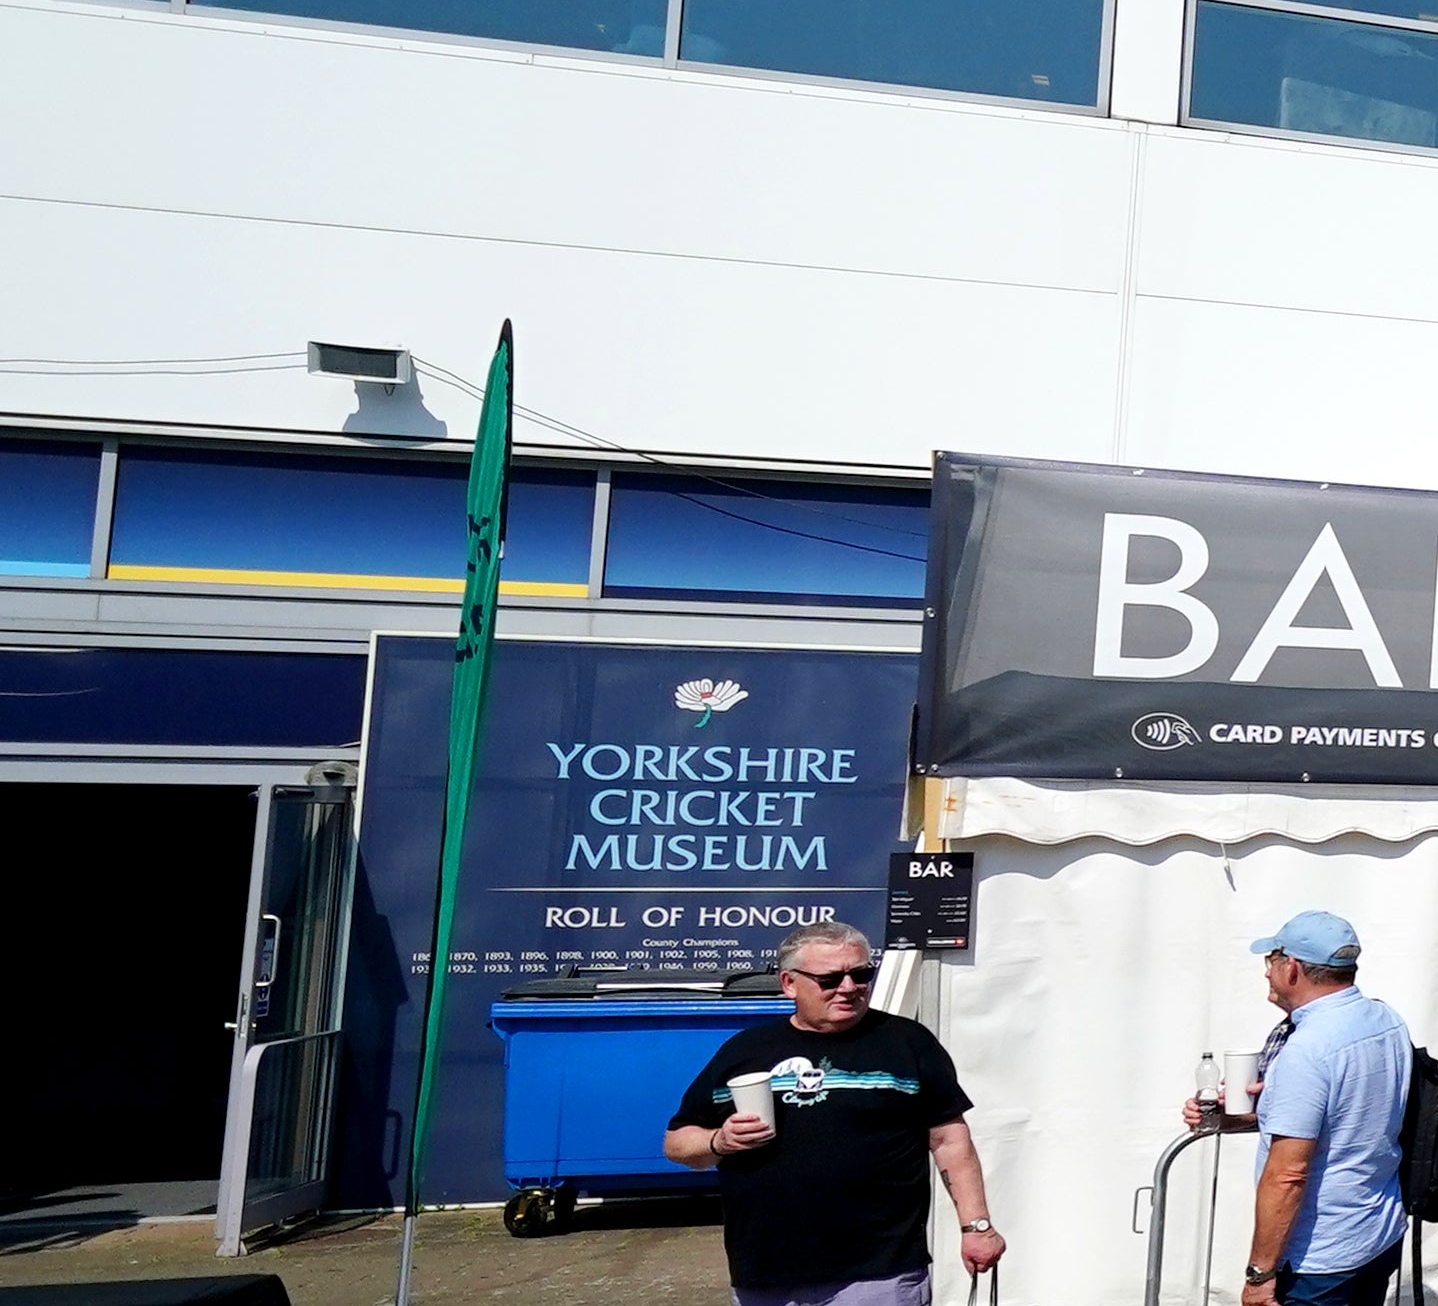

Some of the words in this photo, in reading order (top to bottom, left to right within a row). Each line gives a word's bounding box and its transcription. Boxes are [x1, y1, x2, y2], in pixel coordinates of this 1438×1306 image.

[1209, 722, 1283, 744] CARD
[1290, 725, 1426, 747] PAYMENTS
[545, 741, 859, 784] YORKSHIRE
[589, 788, 816, 827] CRICKET
[564, 832, 830, 872] MUSEUM
[908, 860, 955, 878] BAR
[544, 905, 626, 928] ROLL
[642, 905, 683, 928] OF
[698, 905, 836, 928] HONOUR
[642, 938, 679, 948] County
[682, 938, 739, 948] Champions
